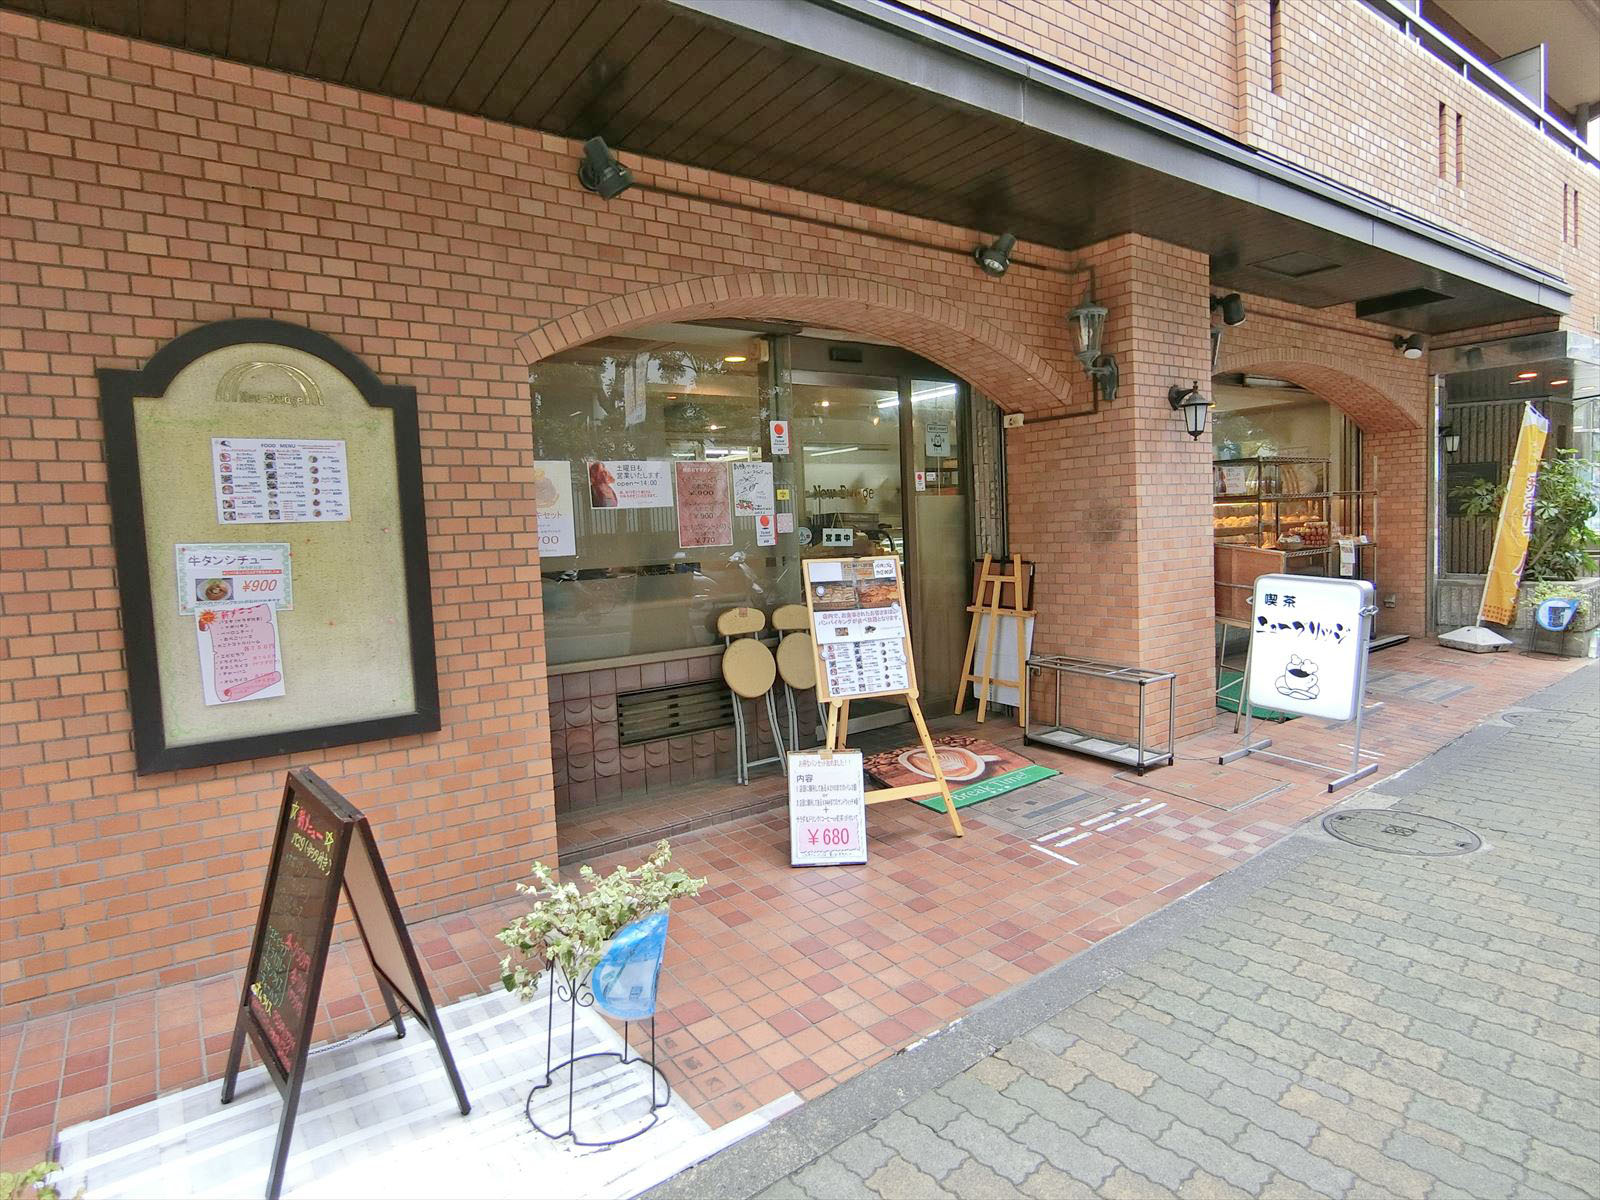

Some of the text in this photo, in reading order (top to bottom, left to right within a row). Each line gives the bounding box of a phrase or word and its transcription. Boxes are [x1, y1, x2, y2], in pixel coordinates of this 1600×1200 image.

[188, 556, 272, 566] 牛タンシチュー
[242, 579, 278, 592] ¥900
[1256, 616, 1351, 644] ニューブリッジ
[796, 774, 812, 782] 内容
[808, 828, 849, 846] ¥680
